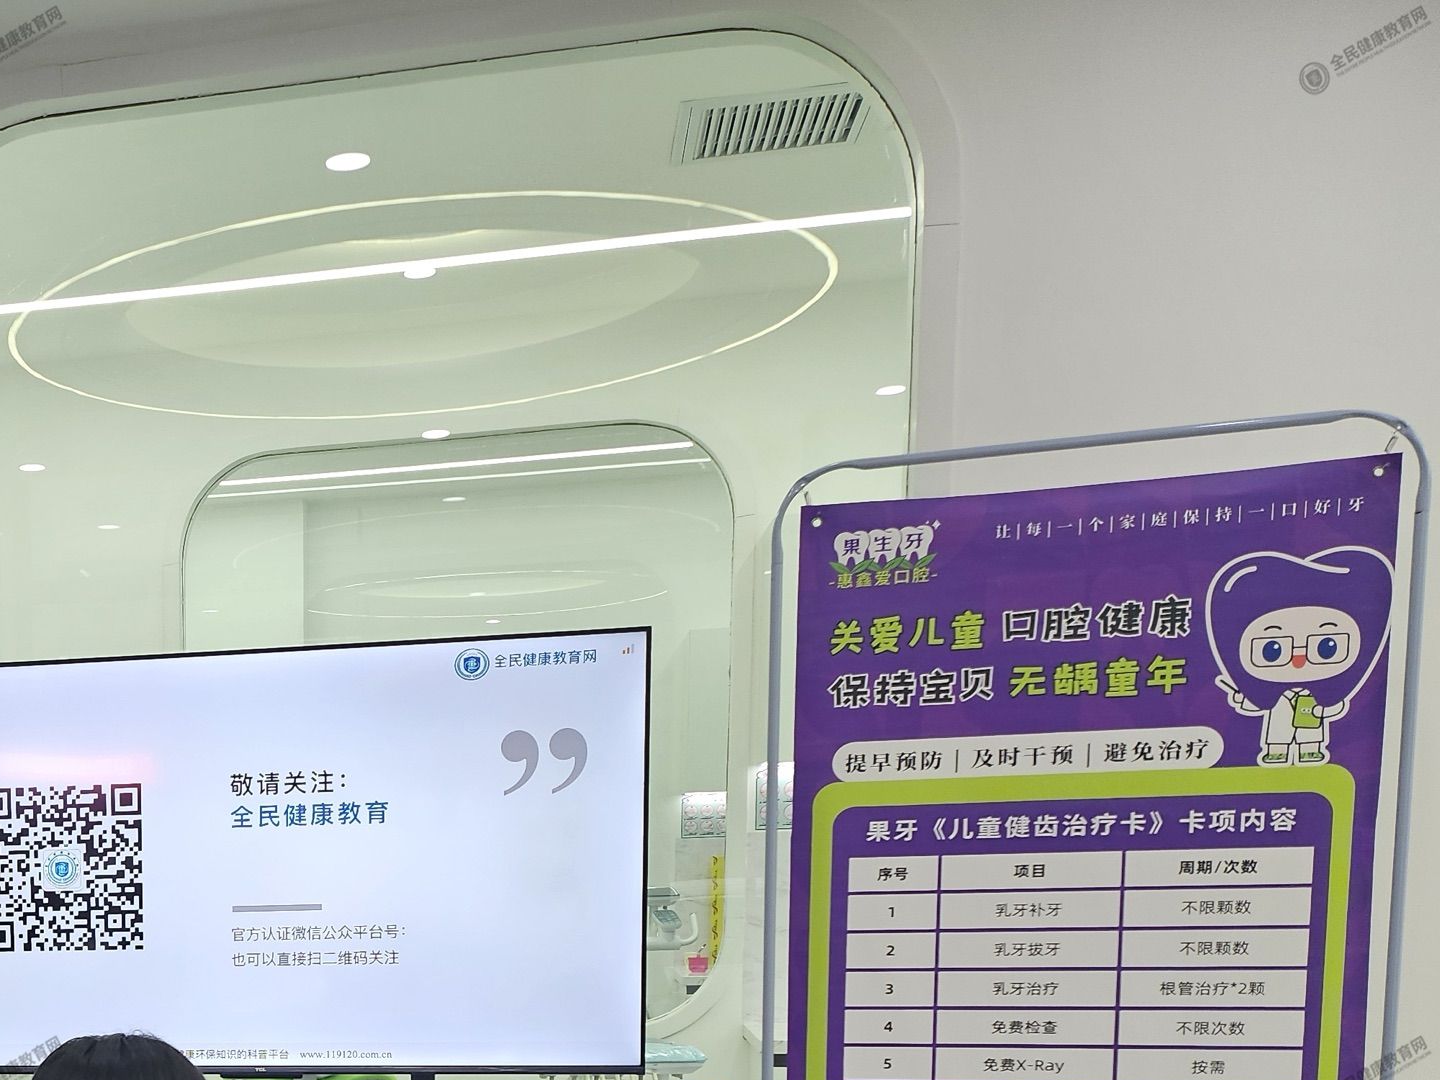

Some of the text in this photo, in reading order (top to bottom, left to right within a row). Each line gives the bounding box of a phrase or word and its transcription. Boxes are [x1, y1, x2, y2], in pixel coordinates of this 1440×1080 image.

[829, 594, 1193, 656] 关爱儿童 口腔健康
[494, 649, 597, 669] 全民健康教育网
[828, 654, 1189, 709] 保持宝贝 无龋童年
[845, 737, 1210, 774] 提早预防 及时干预 避免治疗
[229, 770, 347, 797] 敬请关注：
[230, 801, 389, 829] 全民健康教育
[1179, 806, 1299, 834] 卡项内容
[877, 859, 1258, 882] 序号 项目 周期/次数
[994, 902, 1063, 919] 乳牙补牙
[1180, 899, 1252, 916] 不限颗数
[231, 924, 406, 942] 官方认证微信公众平台号：
[231, 950, 400, 967] 也可以直接扫二维码关注
[885, 939, 1249, 958] 2 乳牙拔牙 不限颗数
[884, 983, 894, 995] 3
[991, 981, 1059, 997] 乳牙治疗
[883, 1019, 1246, 1037] 4 免费检查 不限次数
[299, 1050, 393, 1061] www.119120.com.cn
[883, 1057, 1226, 1076] 5 免费X-Ray 按需
